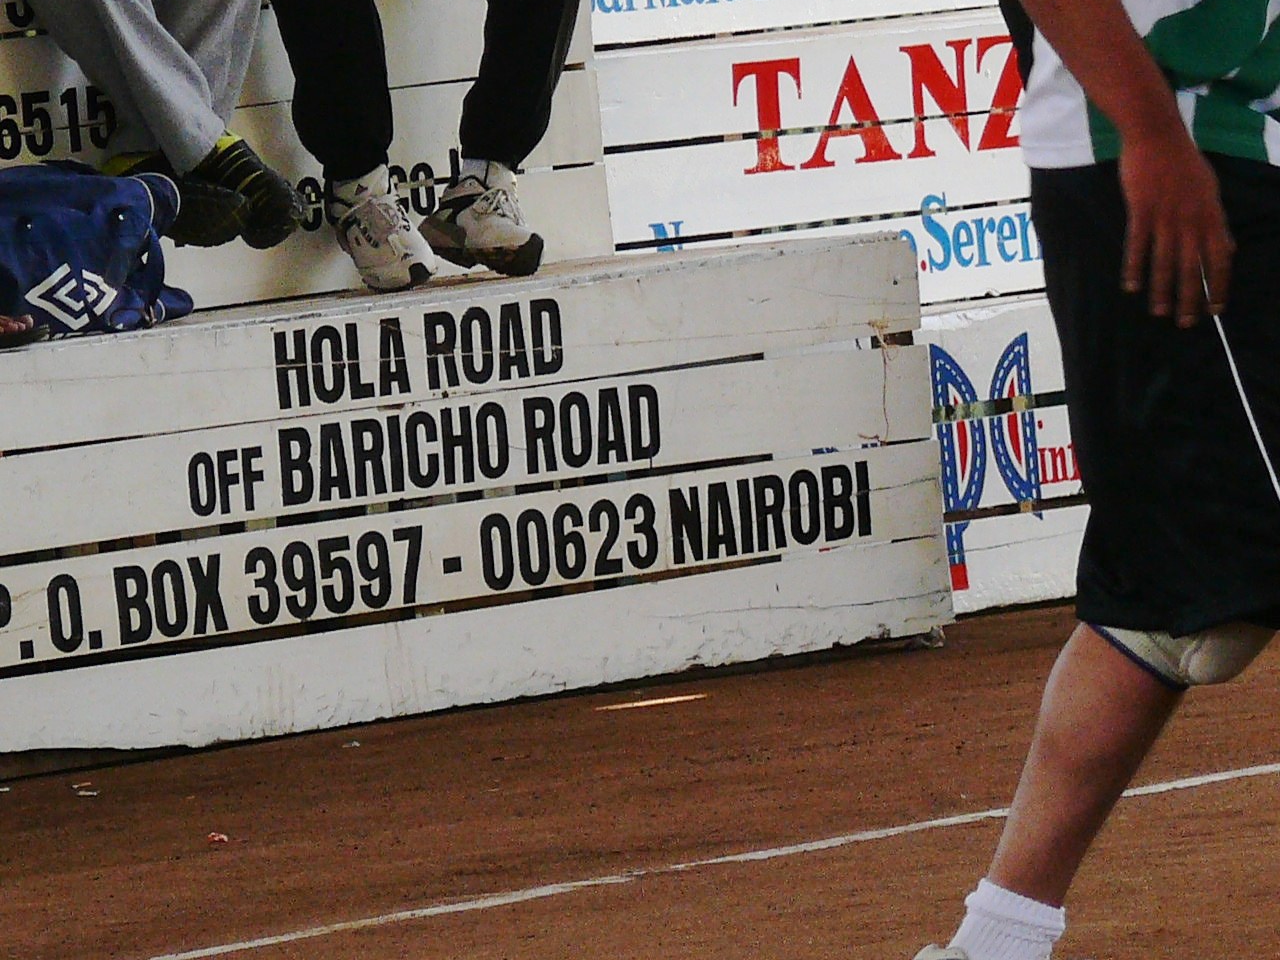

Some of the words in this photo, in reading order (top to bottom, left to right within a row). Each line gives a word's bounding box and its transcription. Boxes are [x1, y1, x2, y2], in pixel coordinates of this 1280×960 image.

[732, 35, 1024, 176] TANZ
[273, 317, 412, 410] HOLA
[424, 298, 564, 391] ROAD
[187, 446, 265, 517] OFF
[278, 401, 510, 507] BARICHO
[523, 384, 661, 475] ROAD
[113, 553, 229, 646] BOX
[244, 525, 423, 625] 39597
[479, 492, 658, 591] 00623
[669, 460, 872, 565] NAIROBI
